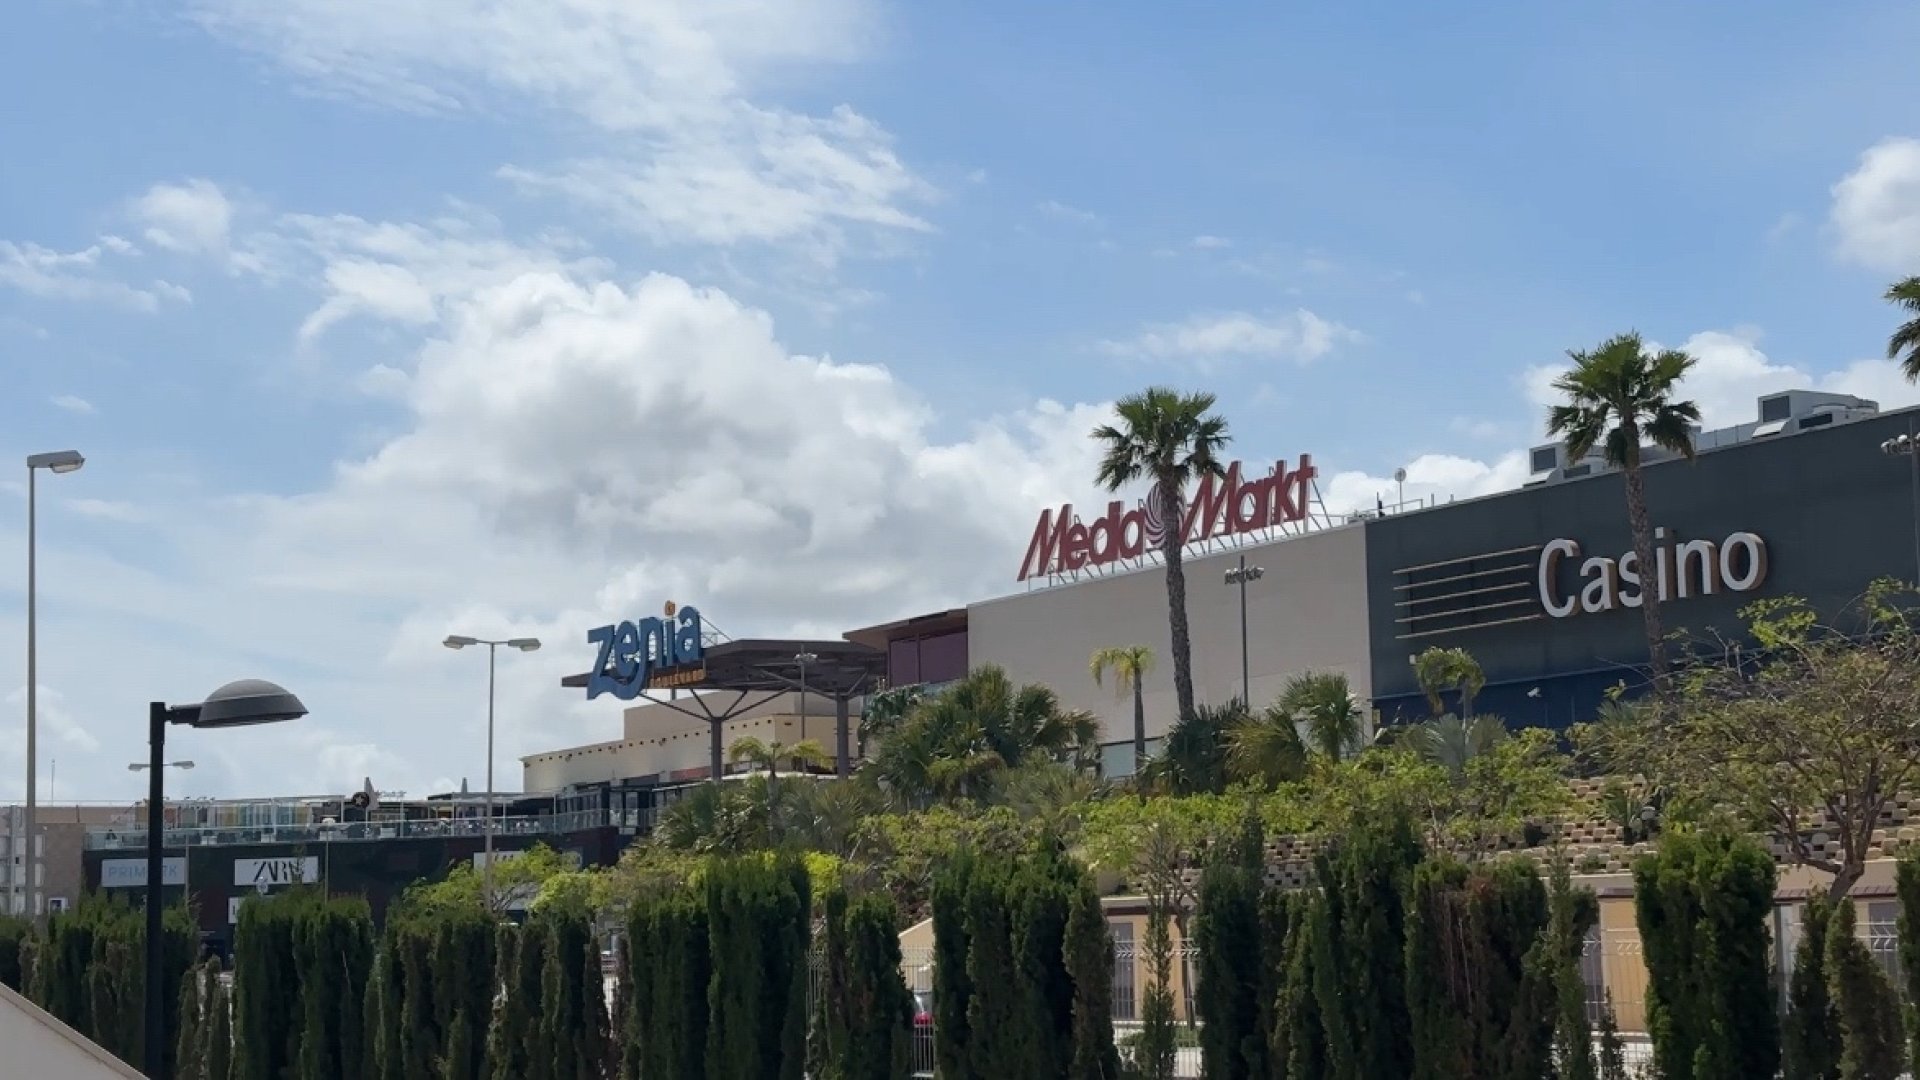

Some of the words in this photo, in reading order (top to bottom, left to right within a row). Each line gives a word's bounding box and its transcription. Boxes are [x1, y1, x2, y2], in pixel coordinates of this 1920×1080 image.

[1180, 453, 1318, 545] Markt
[1538, 526, 1768, 618] Casino
[108, 863, 177, 881] PRIMK
